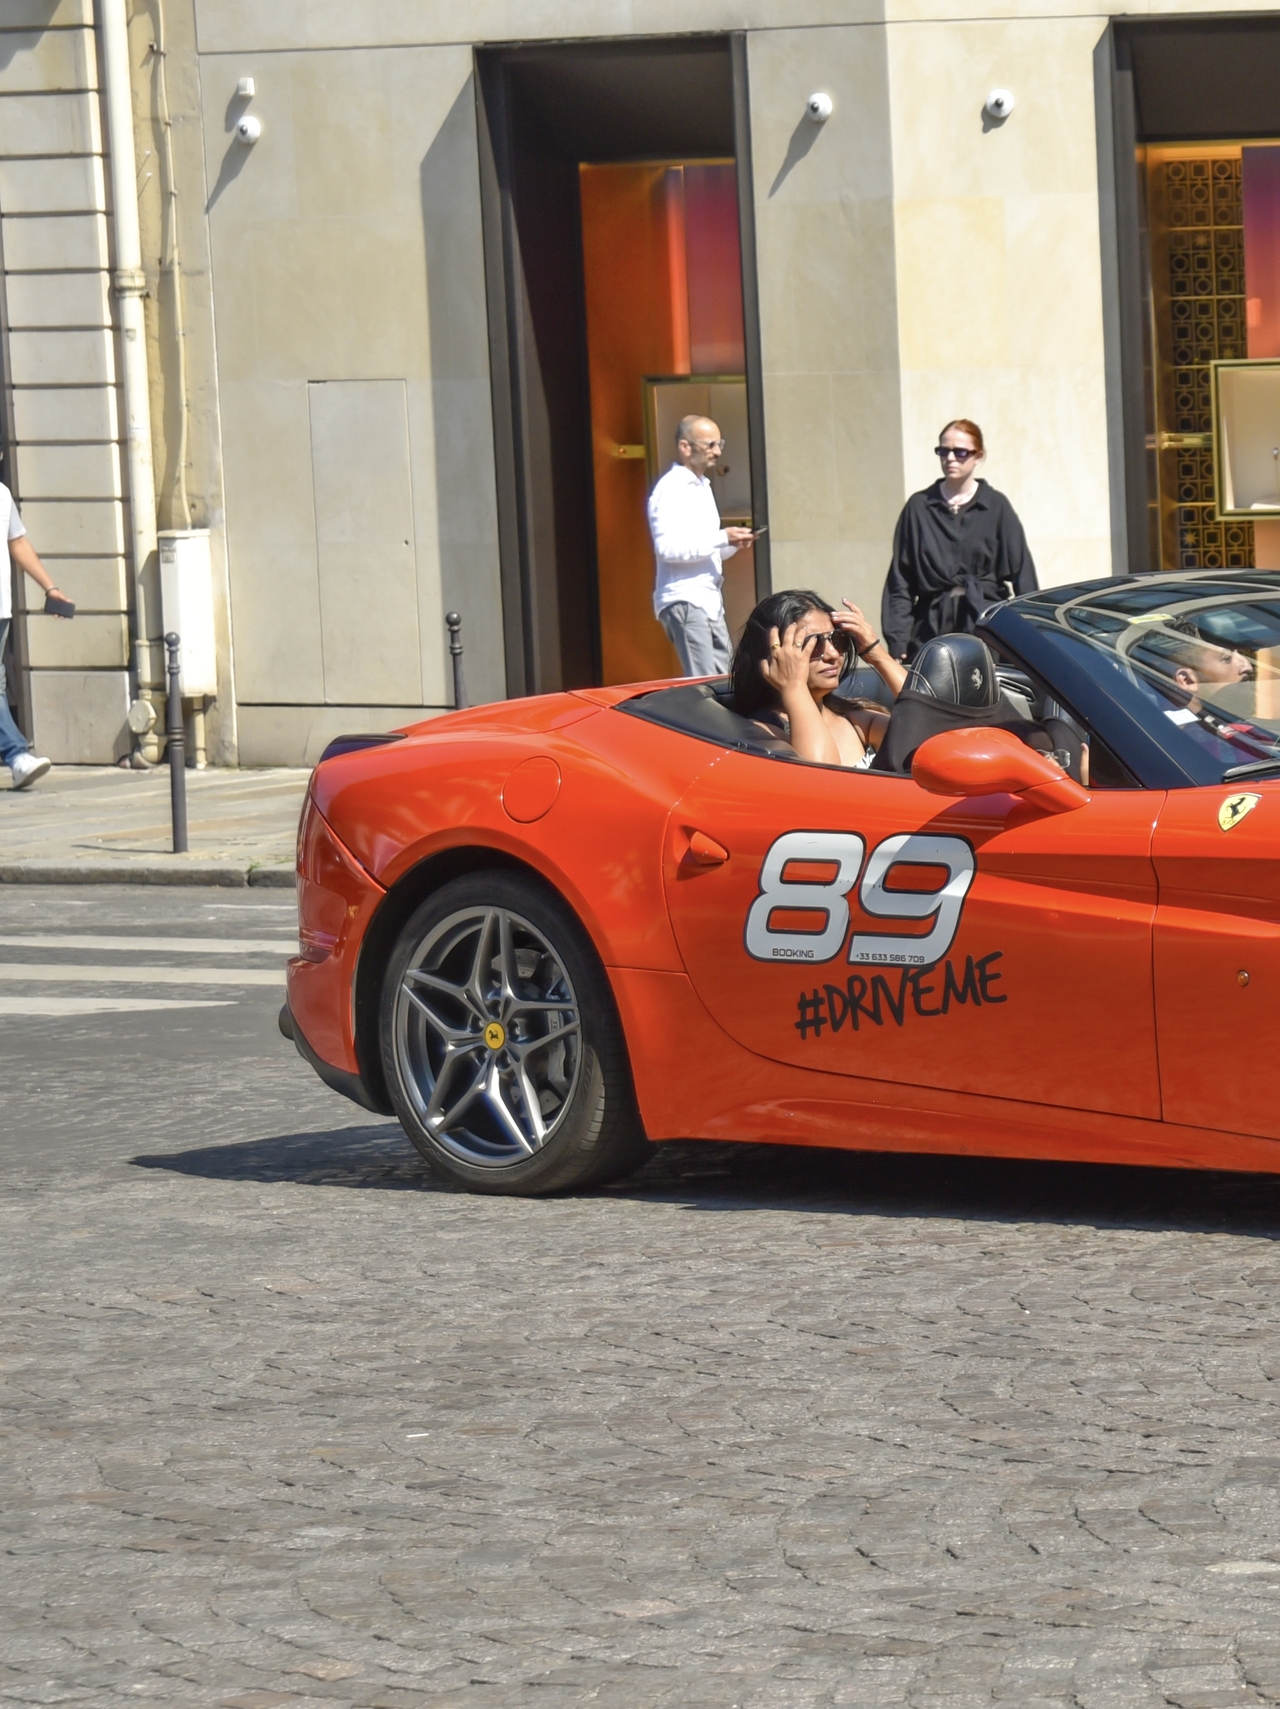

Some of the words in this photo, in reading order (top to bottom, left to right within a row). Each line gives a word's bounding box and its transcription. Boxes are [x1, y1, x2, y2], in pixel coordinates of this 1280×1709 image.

[744, 829, 977, 967] 89
[772, 948, 814, 959] BOOKING
[855, 952, 870, 961] +33
[871, 953, 888, 961] 633
[889, 954, 906, 962] 586
[908, 955, 925, 963] 709
[795, 951, 1007, 1040] #DRIVEME
